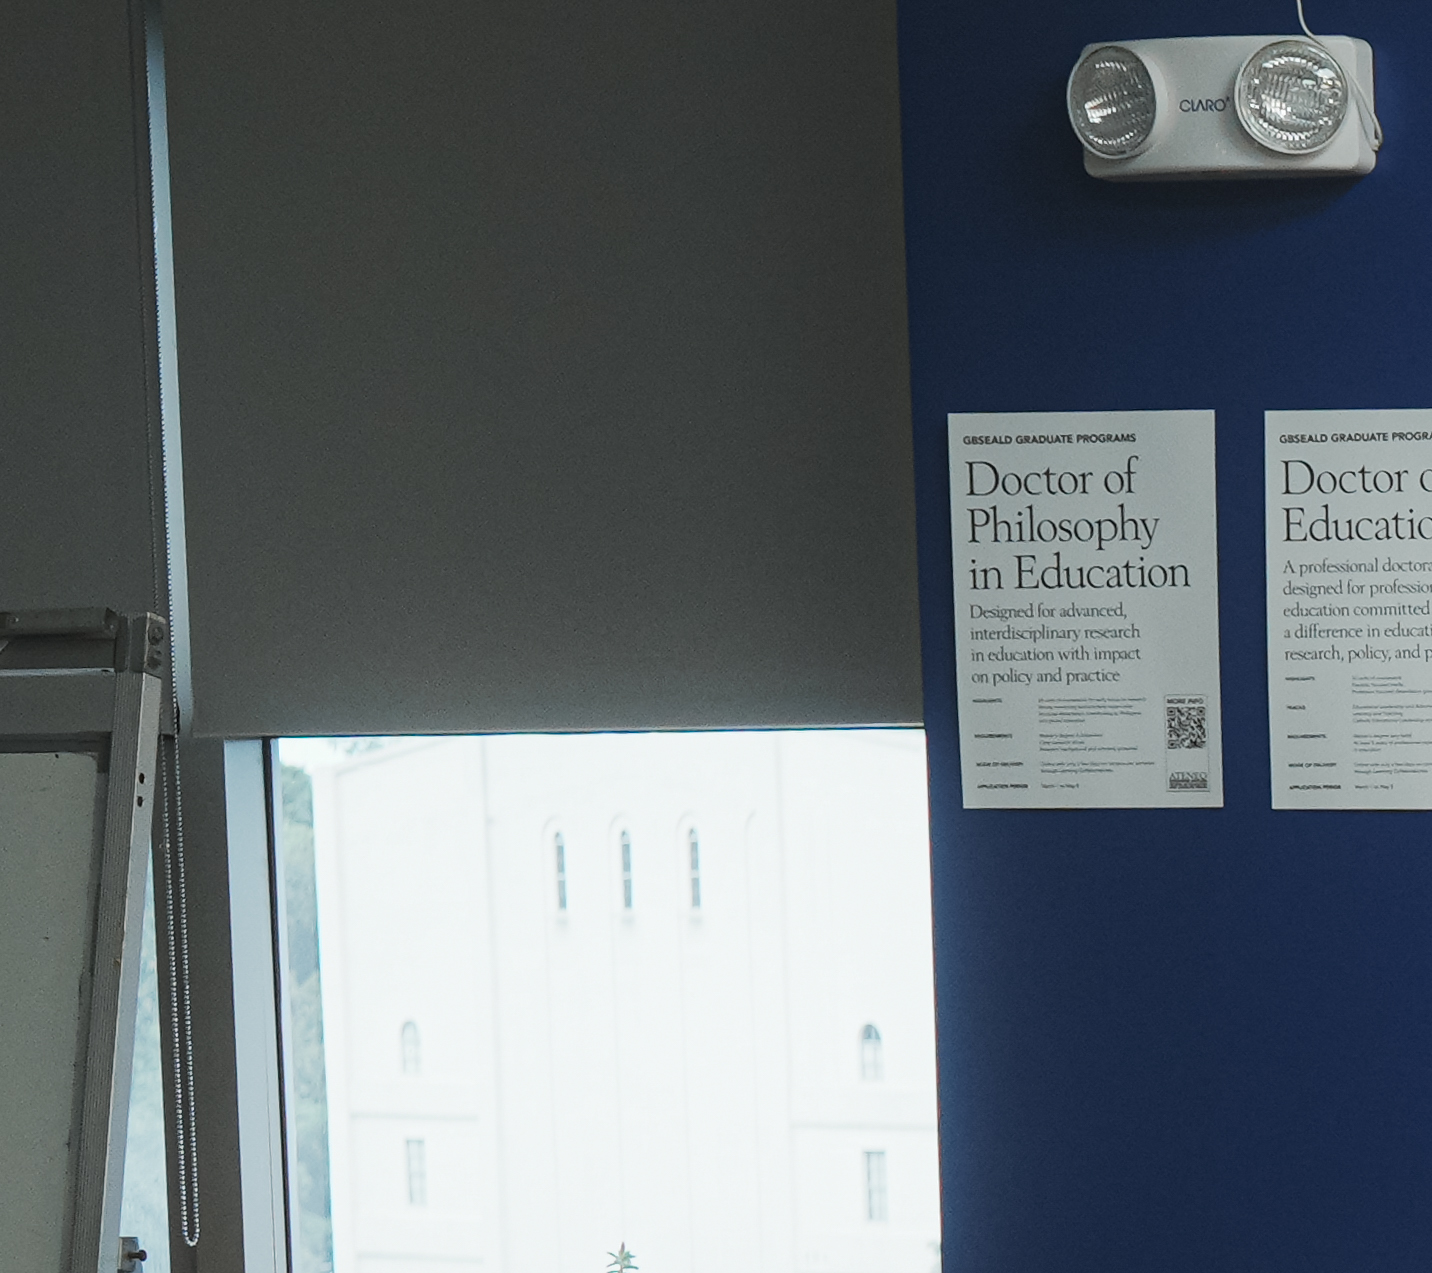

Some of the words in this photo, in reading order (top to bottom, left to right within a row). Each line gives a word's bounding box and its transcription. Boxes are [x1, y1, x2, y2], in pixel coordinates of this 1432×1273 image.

[1179, 98, 1226, 112] CLARO
[963, 435, 1012, 445] GBSEALD
[1015, 434, 1073, 444] GRADUATE
[1076, 433, 1137, 444] PROGRAMS
[1279, 433, 1328, 444] GBSEALD
[1331, 432, 1388, 442] GRADUATE
[965, 461, 1094, 496] Doctor
[1104, 455, 1139, 494] of
[1280, 459, 1409, 495] Doctor
[966, 503, 1160, 551] Philosophy
[969, 558, 1004, 591] in
[1013, 551, 1191, 590] Education
[1282, 560, 1296, 574] A
[1299, 557, 1379, 577] professional
[1282, 579, 1343, 598] designed
[1347, 579, 1366, 594] for
[969, 602, 1035, 622] Designed
[1037, 602, 1055, 618] for
[1059, 601, 1128, 619] advanced,
[1283, 602, 1350, 617] education
[1353, 600, 1430, 617] committed
[970, 624, 1080, 643] interdisciplinary
[1084, 623, 1141, 640] research
[1283, 628, 1291, 639] a
[1294, 622, 1363, 639] difference
[1366, 625, 1380, 638] in
[971, 649, 984, 662] in
[987, 646, 1055, 662] education
[1058, 645, 1090, 661] with
[1093, 647, 1142, 664] impact
[1284, 645, 1345, 662] research,
[1348, 644, 1392, 663] policy,
[1394, 643, 1421, 660] and
[971, 672, 989, 684] on
[992, 667, 1033, 687] policy
[1036, 667, 1062, 683] and
[1066, 669, 1121, 686] practice
